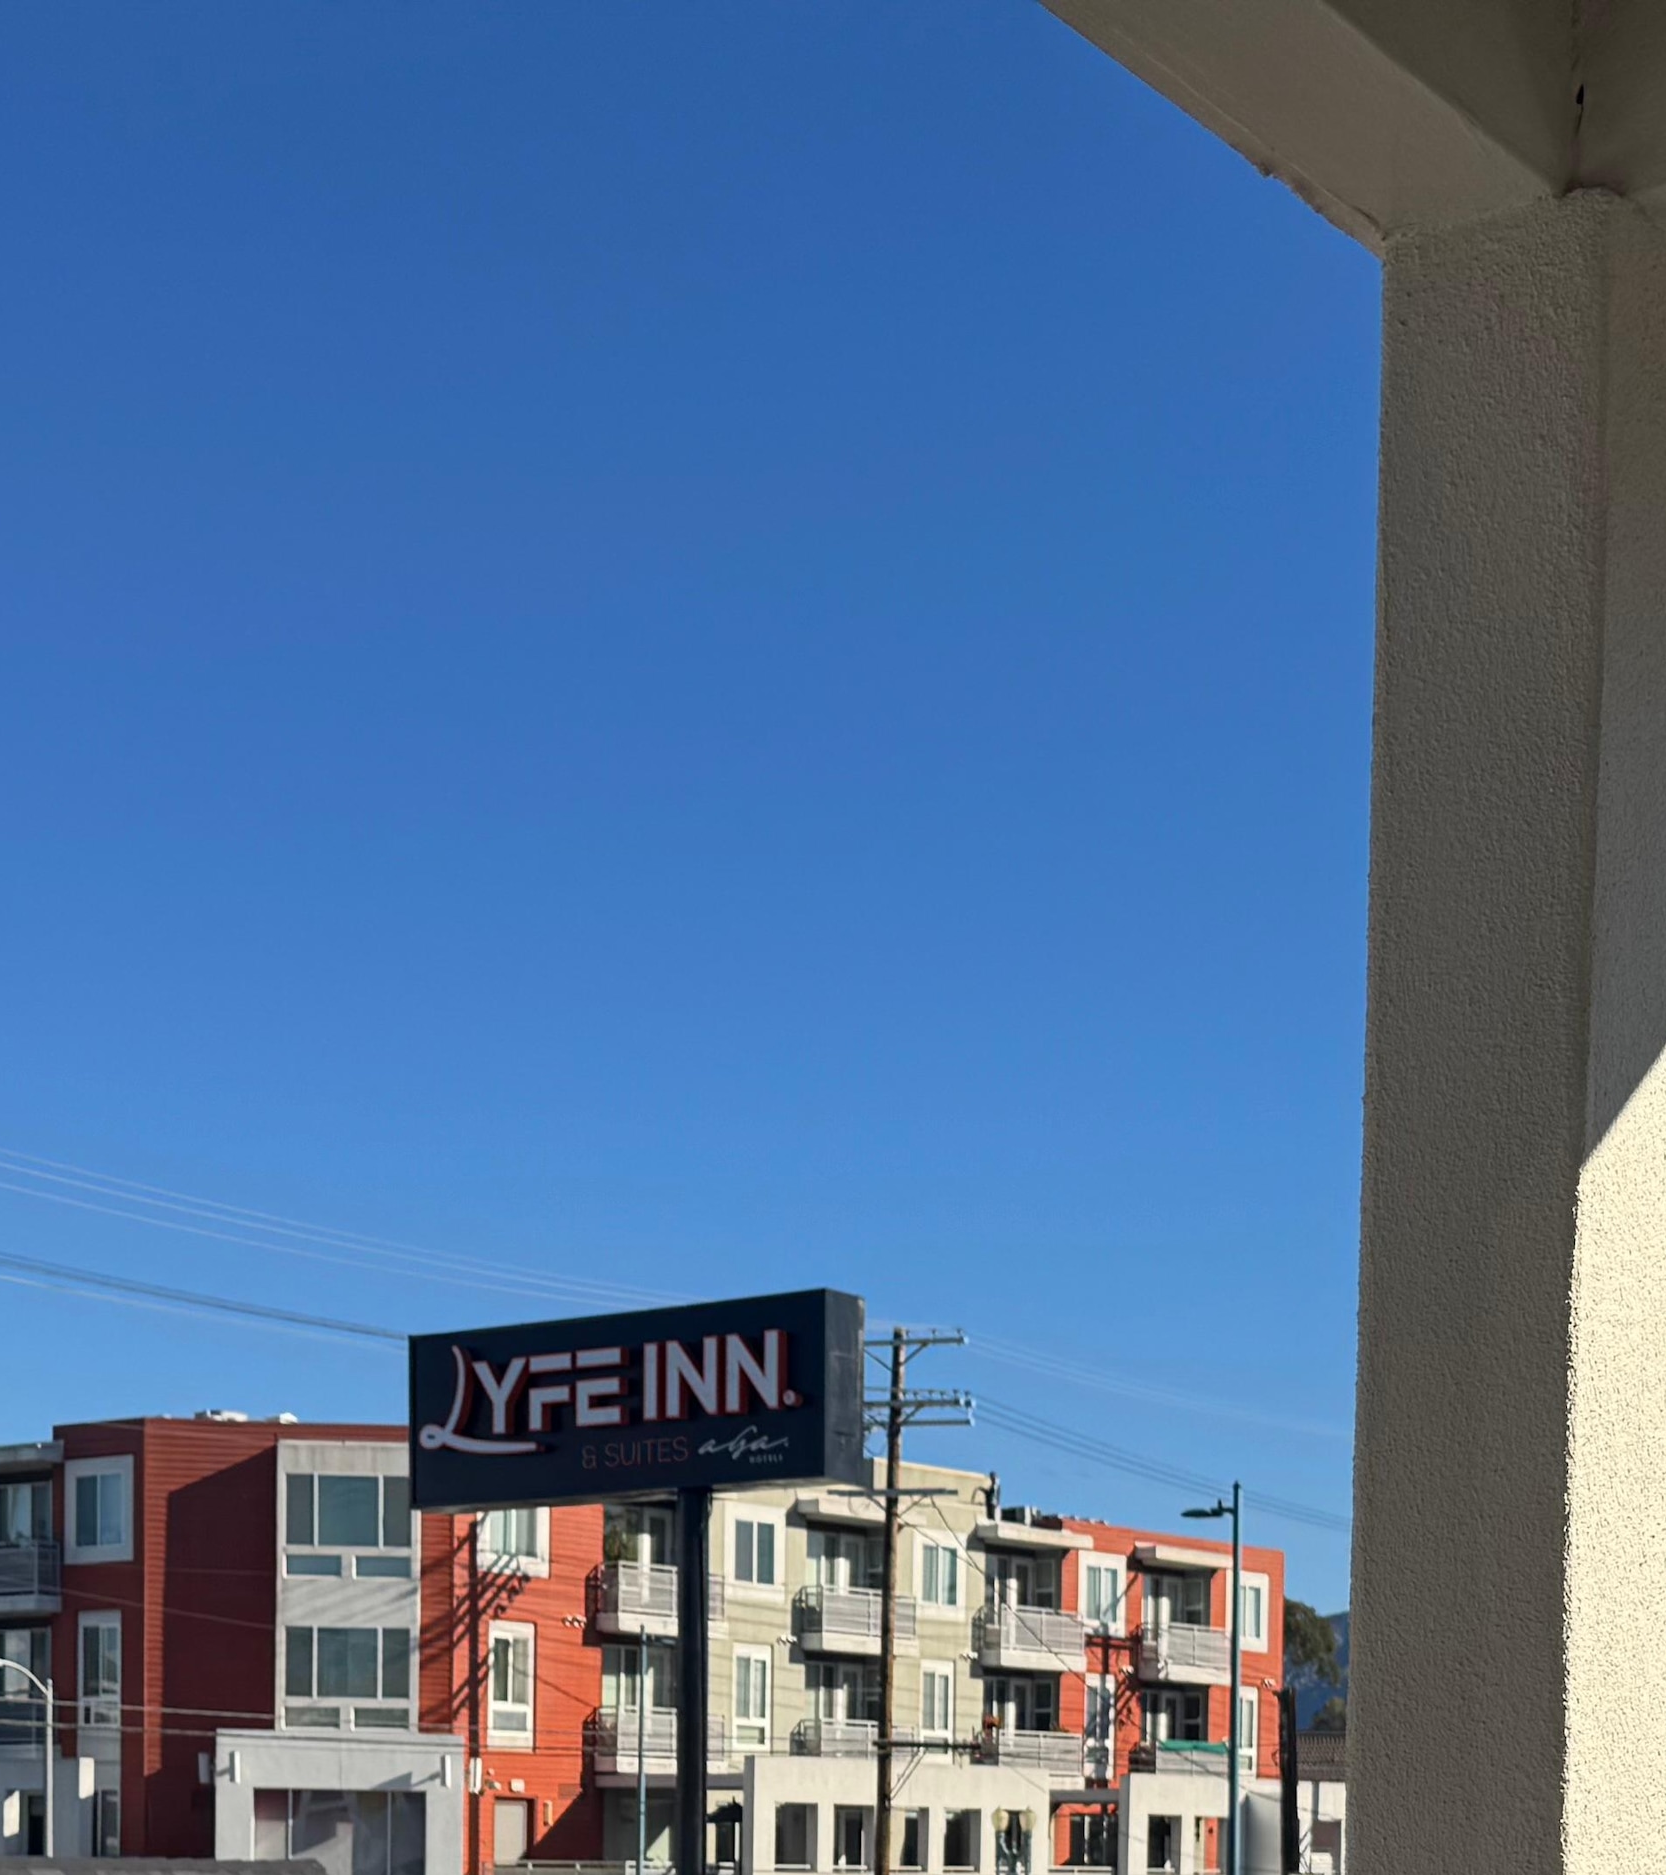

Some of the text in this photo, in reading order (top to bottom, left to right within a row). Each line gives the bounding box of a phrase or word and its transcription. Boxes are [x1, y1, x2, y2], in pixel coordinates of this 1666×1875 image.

[420, 1345, 630, 1454] LYFE
[582, 1436, 688, 1469] & SUITES
